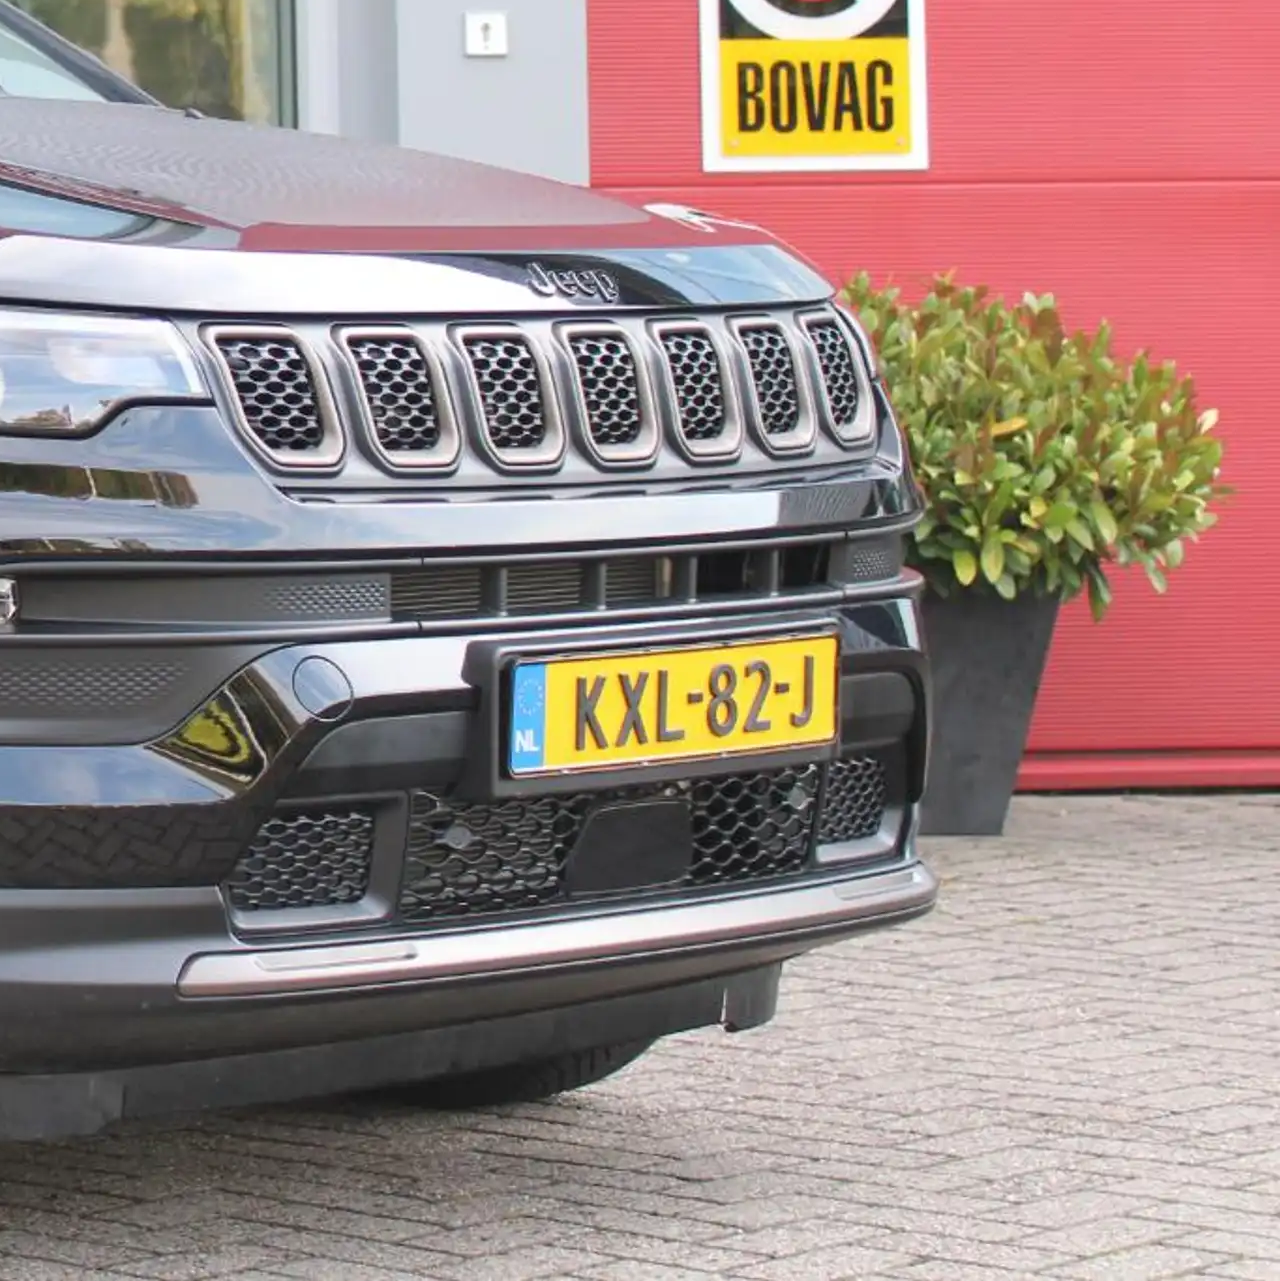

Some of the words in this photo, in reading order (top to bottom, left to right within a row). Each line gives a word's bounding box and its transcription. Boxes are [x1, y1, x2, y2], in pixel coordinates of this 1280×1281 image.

[737, 59, 894, 134] BOVAG
[527, 262, 618, 304] Jeep
[575, 655, 815, 751] KXL-82-J
[515, 729, 540, 753] NL
